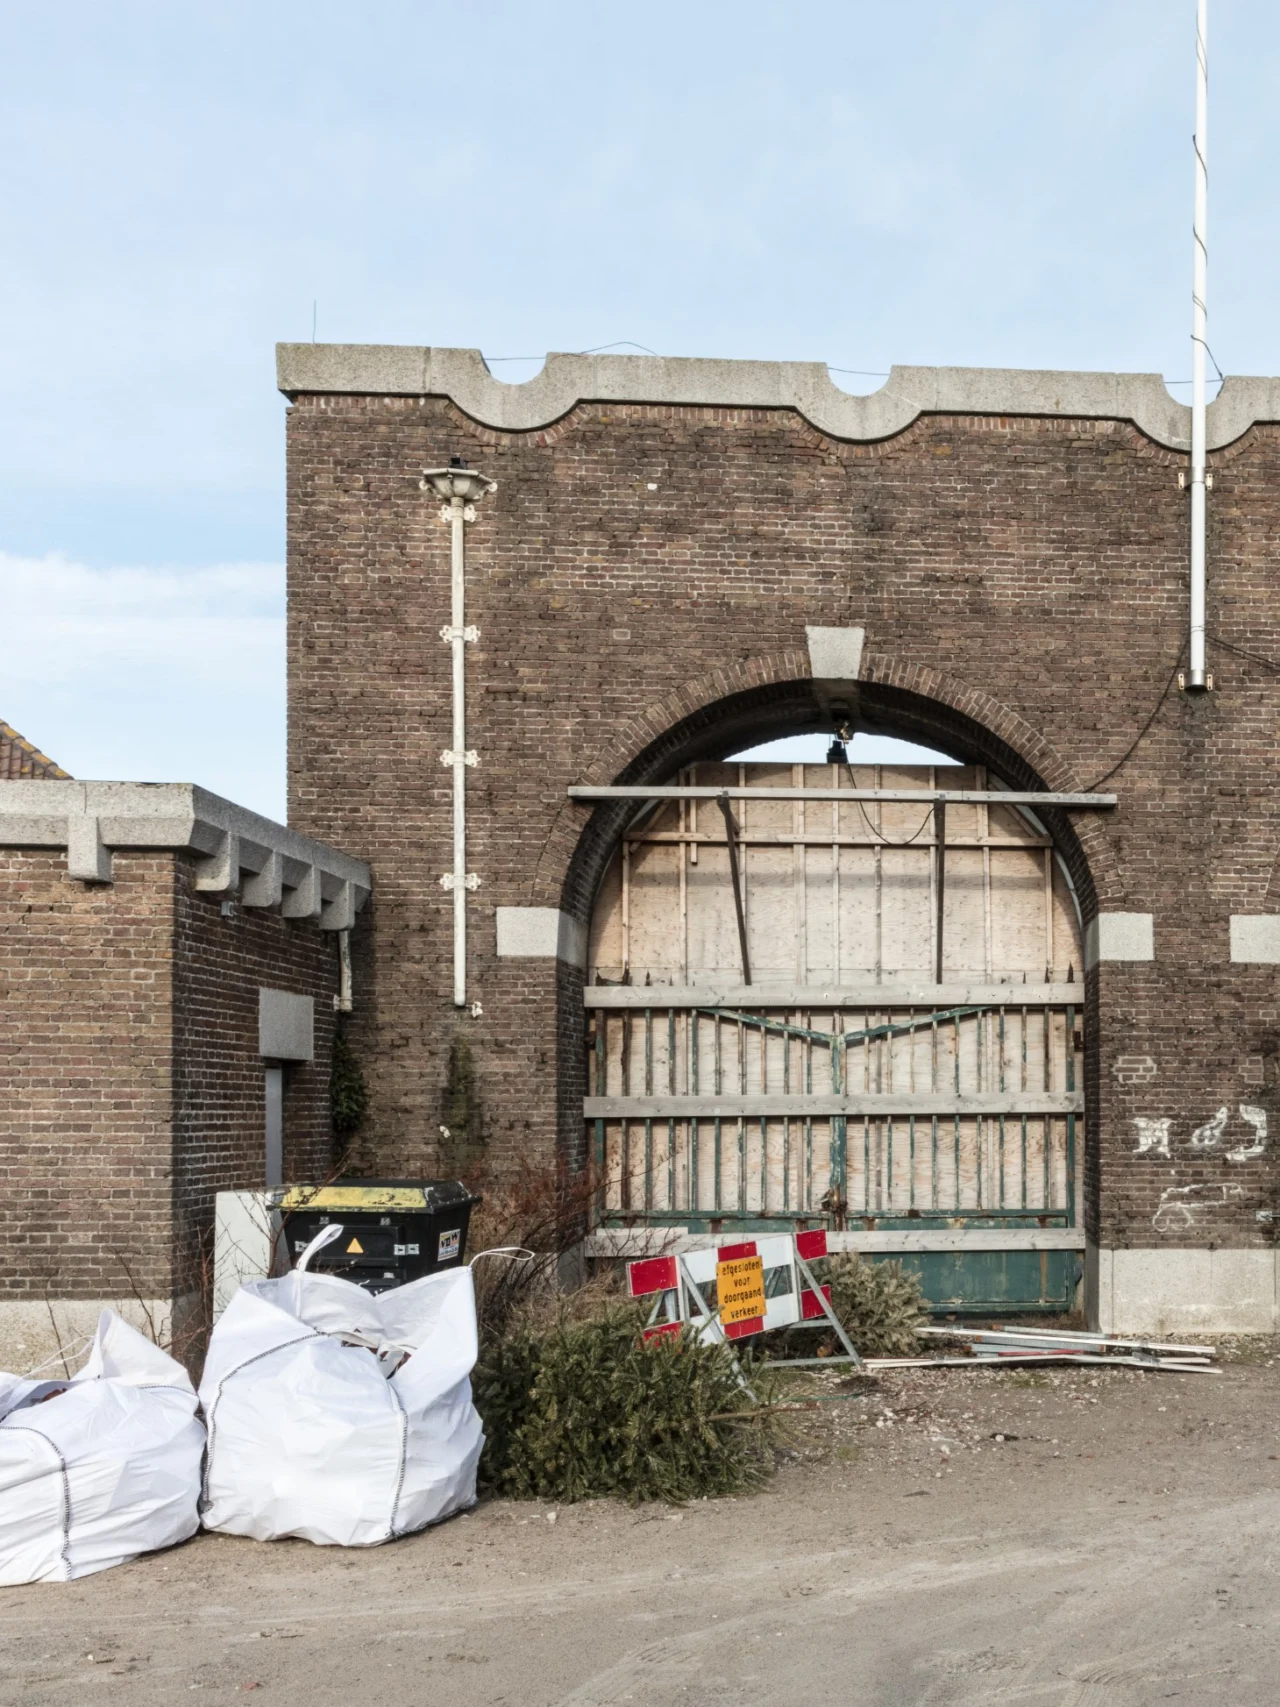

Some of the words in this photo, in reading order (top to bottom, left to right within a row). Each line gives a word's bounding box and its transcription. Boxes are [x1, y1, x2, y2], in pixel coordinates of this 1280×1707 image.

[734, 1276, 750, 1287] voor
[724, 1287, 762, 1303] doorgaand
[731, 1306, 758, 1319] verkeer
